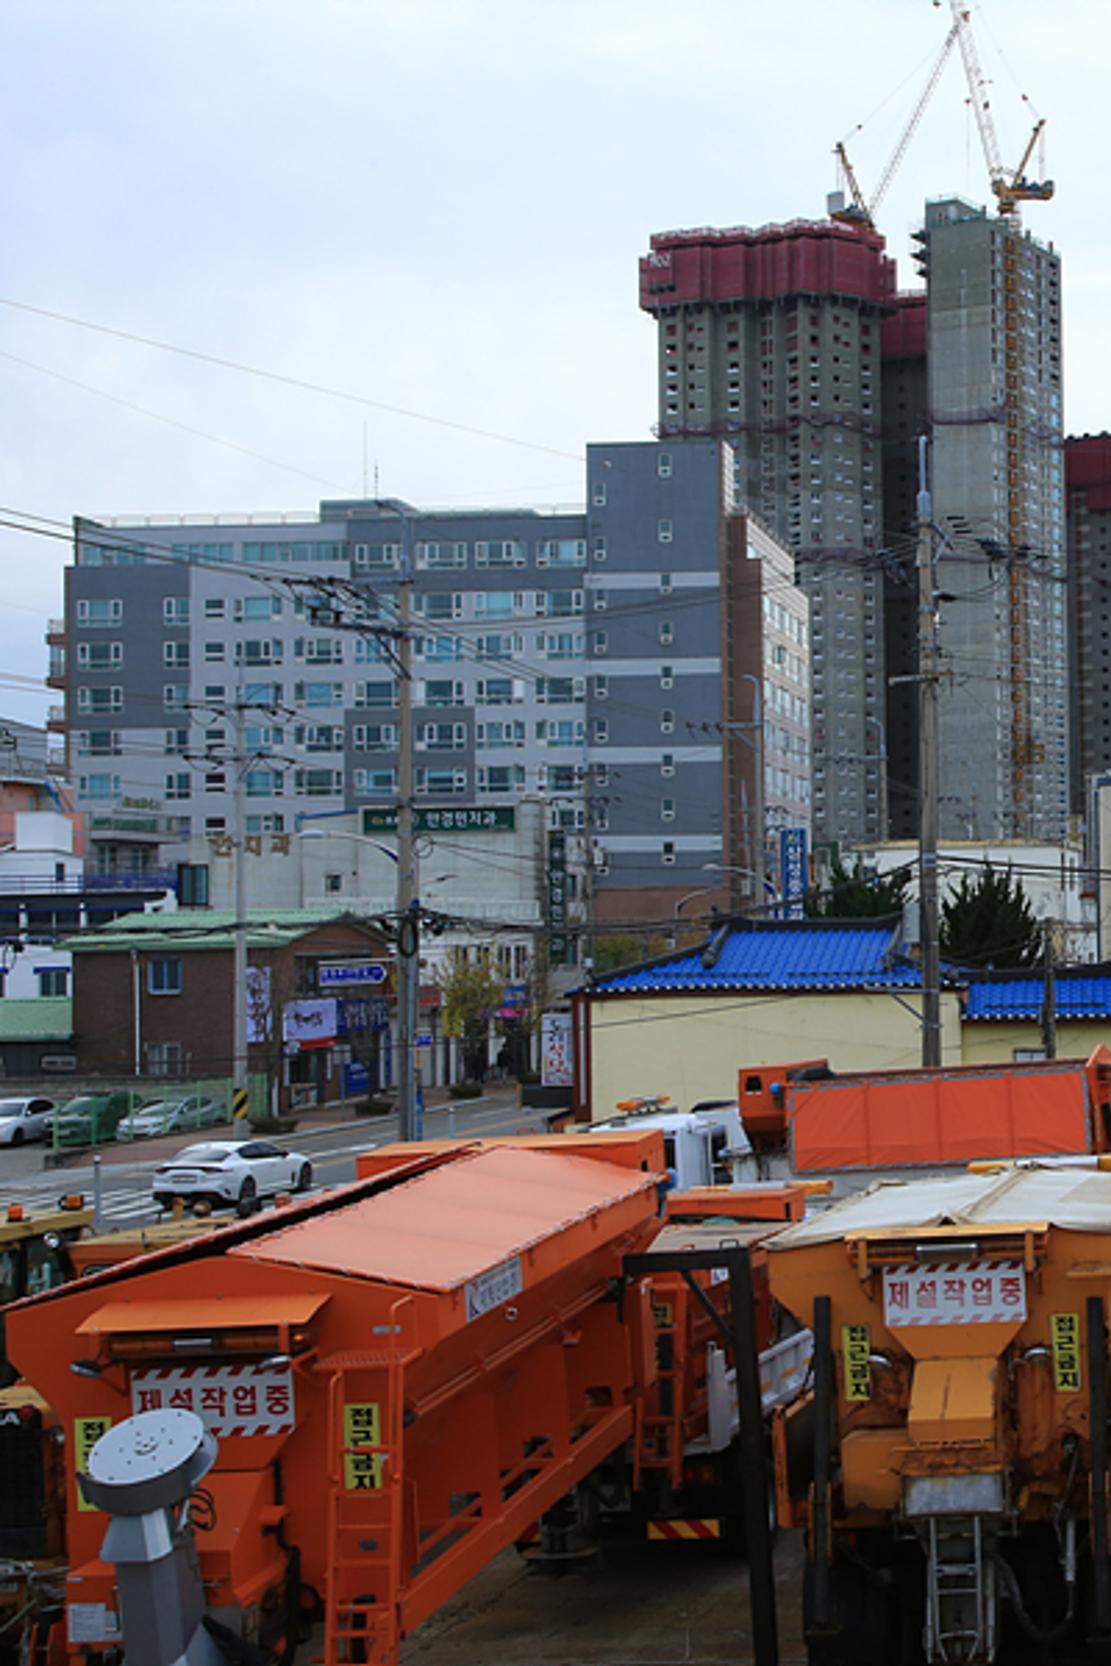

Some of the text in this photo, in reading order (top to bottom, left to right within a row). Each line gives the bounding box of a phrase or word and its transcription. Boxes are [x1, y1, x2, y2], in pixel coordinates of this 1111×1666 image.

[888, 1276, 1021, 1310] 제설작업중
[848, 1325, 871, 1399] 접근금지
[1055, 1315, 1079, 1388] 접근금지
